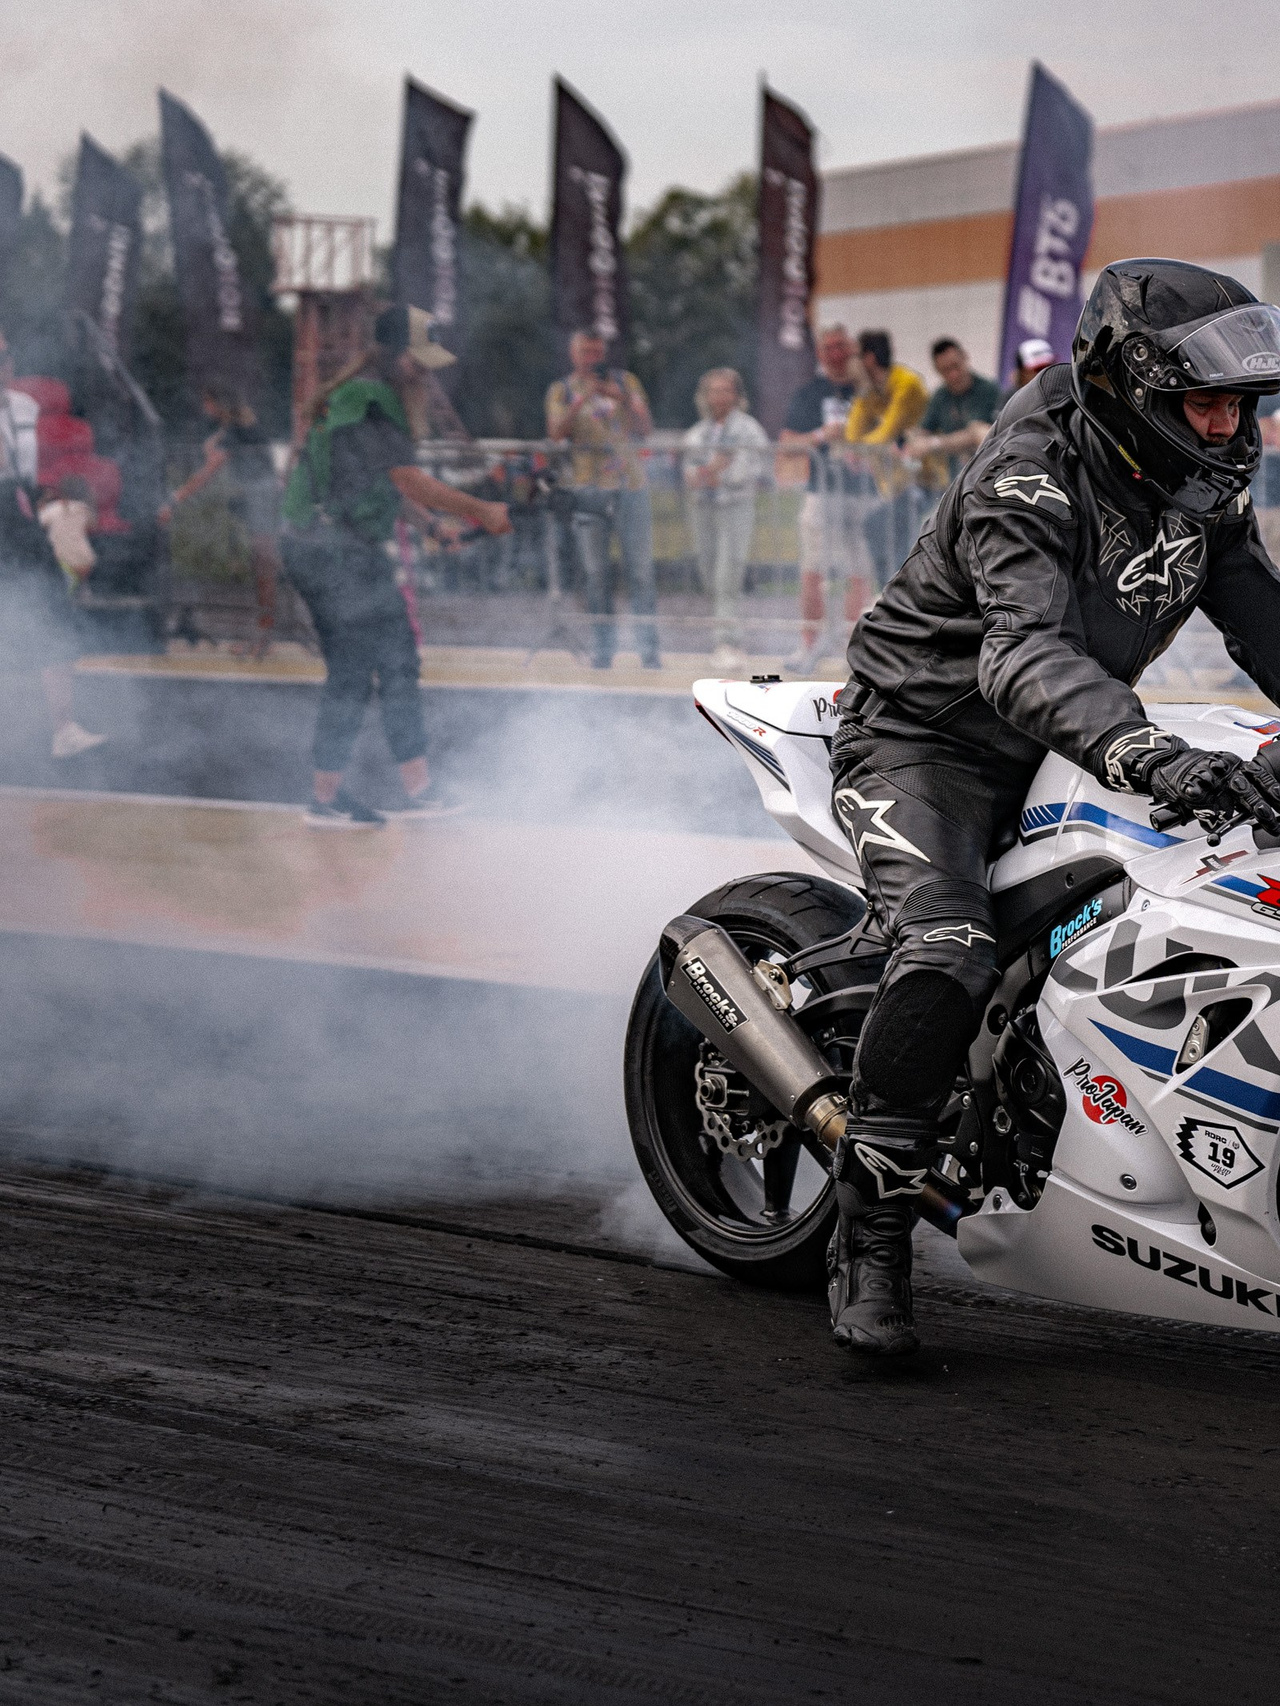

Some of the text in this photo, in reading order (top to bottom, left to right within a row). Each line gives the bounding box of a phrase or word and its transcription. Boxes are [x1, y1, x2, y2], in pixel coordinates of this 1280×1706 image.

[1030, 197, 1079, 299] ВТБ
[1249, 357, 1279, 369] HJC
[1050, 898, 1103, 959] Brock's
[1062, 917, 1097, 949] PERFORMANCE
[685, 961, 738, 1025] Brock's
[692, 981, 730, 1028] PERFORMANCE
[1063, 1057, 1147, 1135] ProJapan
[1207, 1141, 1236, 1169] 19
